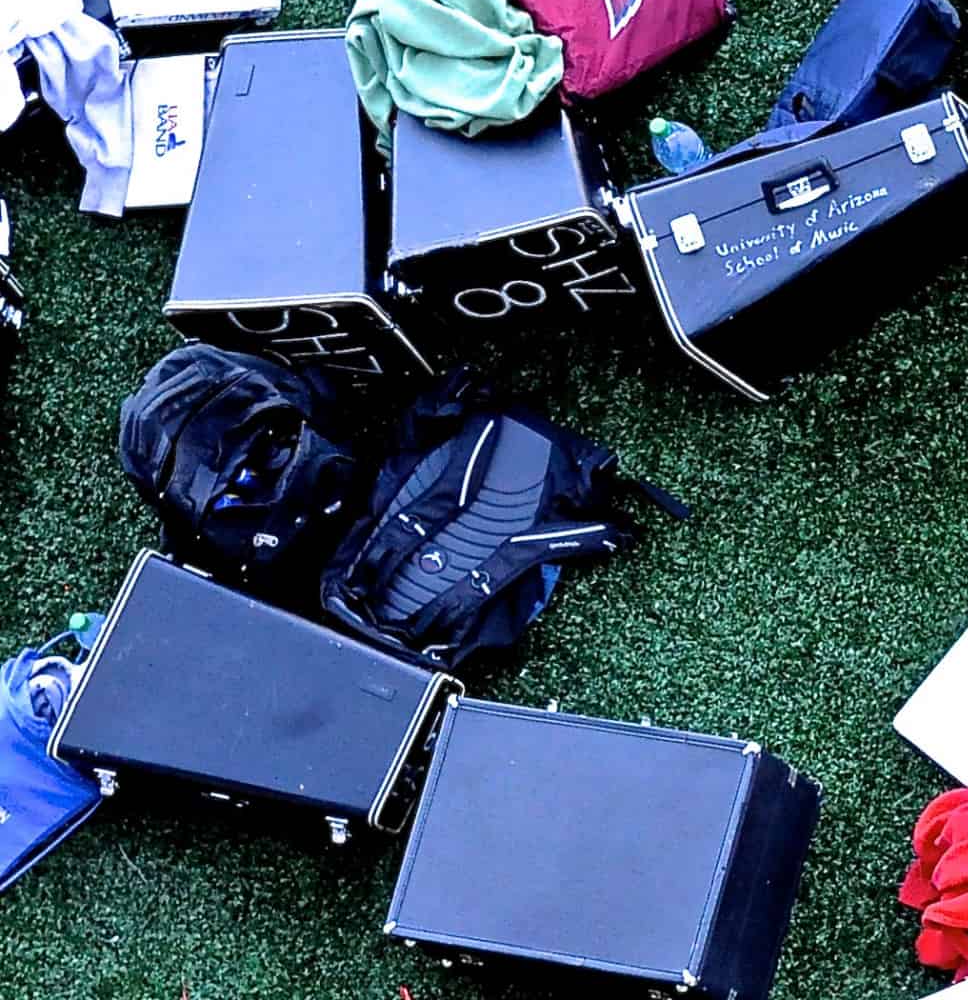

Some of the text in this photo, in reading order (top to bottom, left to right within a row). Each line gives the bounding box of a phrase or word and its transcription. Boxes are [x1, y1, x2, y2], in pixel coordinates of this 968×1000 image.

[155, 104, 168, 158] BAND
[166, 105, 178, 132] UA
[509, 226, 637, 312] SHZ
[725, 246, 781, 277] School
[810, 220, 859, 249] Music
[454, 279, 547, 318] 8
